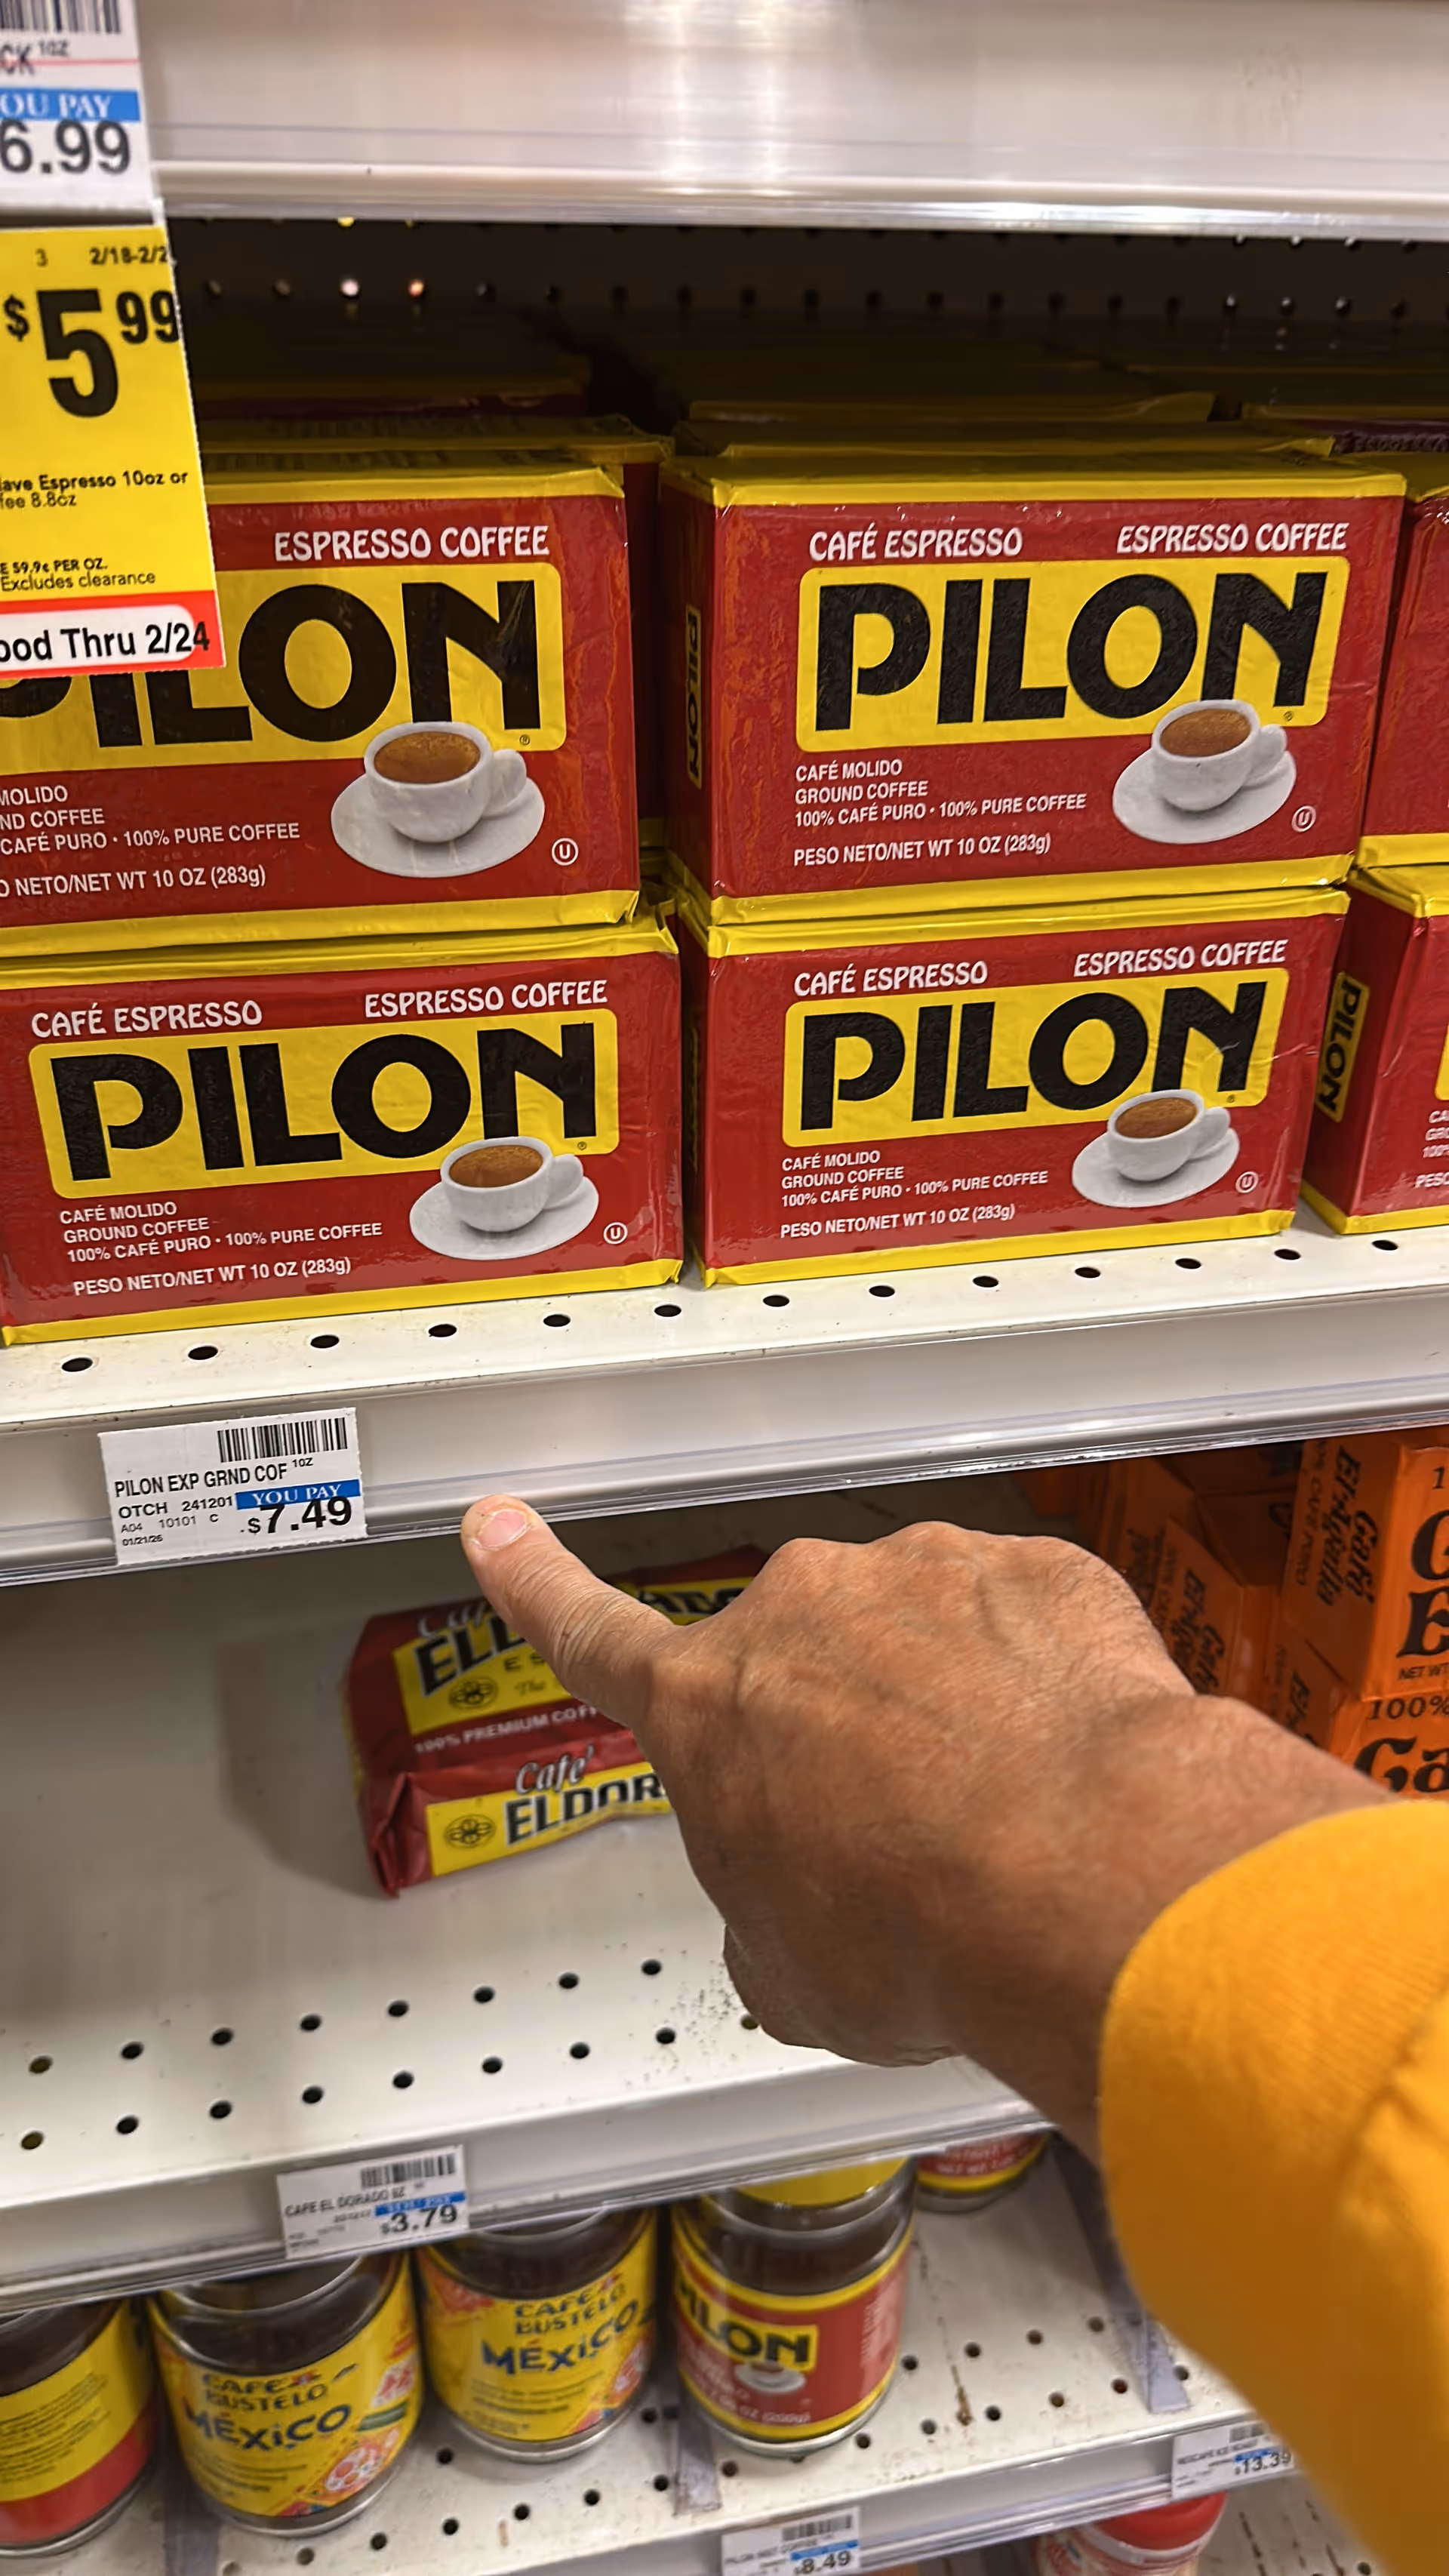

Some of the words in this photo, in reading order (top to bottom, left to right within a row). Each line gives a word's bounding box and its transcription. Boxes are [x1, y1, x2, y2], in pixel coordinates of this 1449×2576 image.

[59, 94, 111, 118] PAY
[0, 118, 130, 175] 6.99
[36, 248, 48, 266] 3
[38, 473, 115, 494] Espresso
[122, 470, 165, 487] 10oz
[170, 472, 188, 484] or
[274, 527, 432, 562] ESPRESSO
[440, 525, 550, 558] COFFEE
[809, 522, 878, 562] CAFÉ
[884, 527, 1023, 559] ESPRESSO
[1116, 523, 1250, 554] ESPRESSO
[1255, 522, 1350, 551] COFFEE
[1, 574, 74, 592] Excludes
[78, 571, 156, 588] clearance
[53, 558, 81, 572] PER
[60, 626, 137, 660] Thru
[145, 620, 211, 655] 2/24
[814, 571, 1329, 732] PILON
[795, 761, 839, 782] CAFÉ
[842, 759, 903, 780] MOLIDO
[795, 784, 863, 805] GROUND
[867, 780, 929, 801] COFFEE
[30, 808, 105, 829] COFFEE
[795, 809, 835, 828] 100%
[838, 802, 879, 825] CAFÉ
[882, 802, 926, 822] PURO
[939, 800, 978, 819] 100%
[982, 796, 1023, 816] PURE
[1026, 792, 1088, 813] COFFEE
[1, 831, 51, 856] CAFÉ
[55, 832, 107, 851] PURO
[123, 829, 171, 848] 100%
[174, 825, 224, 845] PURE
[228, 822, 300, 842] COFFEE
[794, 846, 839, 867] PESO
[843, 840, 924, 863] NETO/NET
[928, 838, 954, 858] WT
[958, 837, 974, 855] 10
[978, 835, 1001, 854] OZ
[1004, 832, 1051, 857] (283g)
[15, 873, 112, 897] NETO/NET
[116, 870, 148, 891] WT
[152, 868, 174, 889] 10
[178, 866, 207, 888] OZ
[211, 863, 266, 891] (283g)
[794, 963, 857, 997] CAFÉ
[863, 960, 988, 992] ESPRESSO
[1073, 945, 1196, 977] ESPRESSO
[1200, 939, 1288, 968] COFFEE
[31, 1002, 107, 1039] CAFÉ
[114, 999, 263, 1033] ESPRESSO
[365, 986, 504, 1018] ESPRESSO
[511, 980, 608, 1008] COFFEE
[800, 980, 1268, 1131] PILON
[1318, 978, 1363, 1114] PILON
[50, 1022, 596, 1182] PILON
[781, 1171, 844, 1190] GROUND
[847, 1165, 905, 1184] COFFEE
[782, 1153, 822, 1171] CAFÉ
[824, 1150, 881, 1168] MOLIDO
[781, 1192, 817, 1208] 100%
[820, 1185, 859, 1204] CAFÉ
[862, 1183, 903, 1201] PURO
[914, 1180, 949, 1196] 100%
[952, 1176, 990, 1193] PURE
[992, 1170, 1049, 1190] COFFEE
[60, 1205, 106, 1225] CAFÉ
[110, 1201, 178, 1221] MOLIDO
[780, 1220, 823, 1239] PESO
[826, 1213, 900, 1236] NETO/NET
[903, 1210, 927, 1227] WT
[930, 1208, 946, 1225] 10
[948, 1207, 970, 1223] OZ
[972, 1203, 1016, 1224] (283g)
[63, 1223, 138, 1244] GROUND
[142, 1217, 210, 1237] COFFEE
[67, 1247, 111, 1263] 100%
[114, 1239, 160, 1260] CAFÉ
[165, 1236, 211, 1254] PURO
[225, 1230, 267, 1247] 100%
[270, 1227, 315, 1245] PURE
[318, 1222, 383, 1241] COFFEE
[73, 1276, 123, 1297] PESO
[127, 1268, 215, 1292] NETO/NET
[218, 1264, 246, 1282] WT
[251, 1263, 269, 1280] 10
[273, 1260, 298, 1278] OZ
[302, 1256, 352, 1279] (283g)
[115, 1476, 165, 1498] PILON
[168, 1472, 199, 1492] EXP
[204, 1467, 251, 1488] GRND
[254, 1462, 288, 1482] COF
[251, 1487, 299, 1507] YOU
[305, 1484, 341, 1499] PAY
[118, 1501, 168, 1519] OTCH
[181, 1496, 234, 1512] 241201
[158, 1515, 197, 1529] 10101
[209, 1513, 220, 1523] C
[247, 1494, 353, 1534] $7.49
[463, 1712, 549, 1744] PREMIUM
[285, 2201, 317, 2217] CAFE
